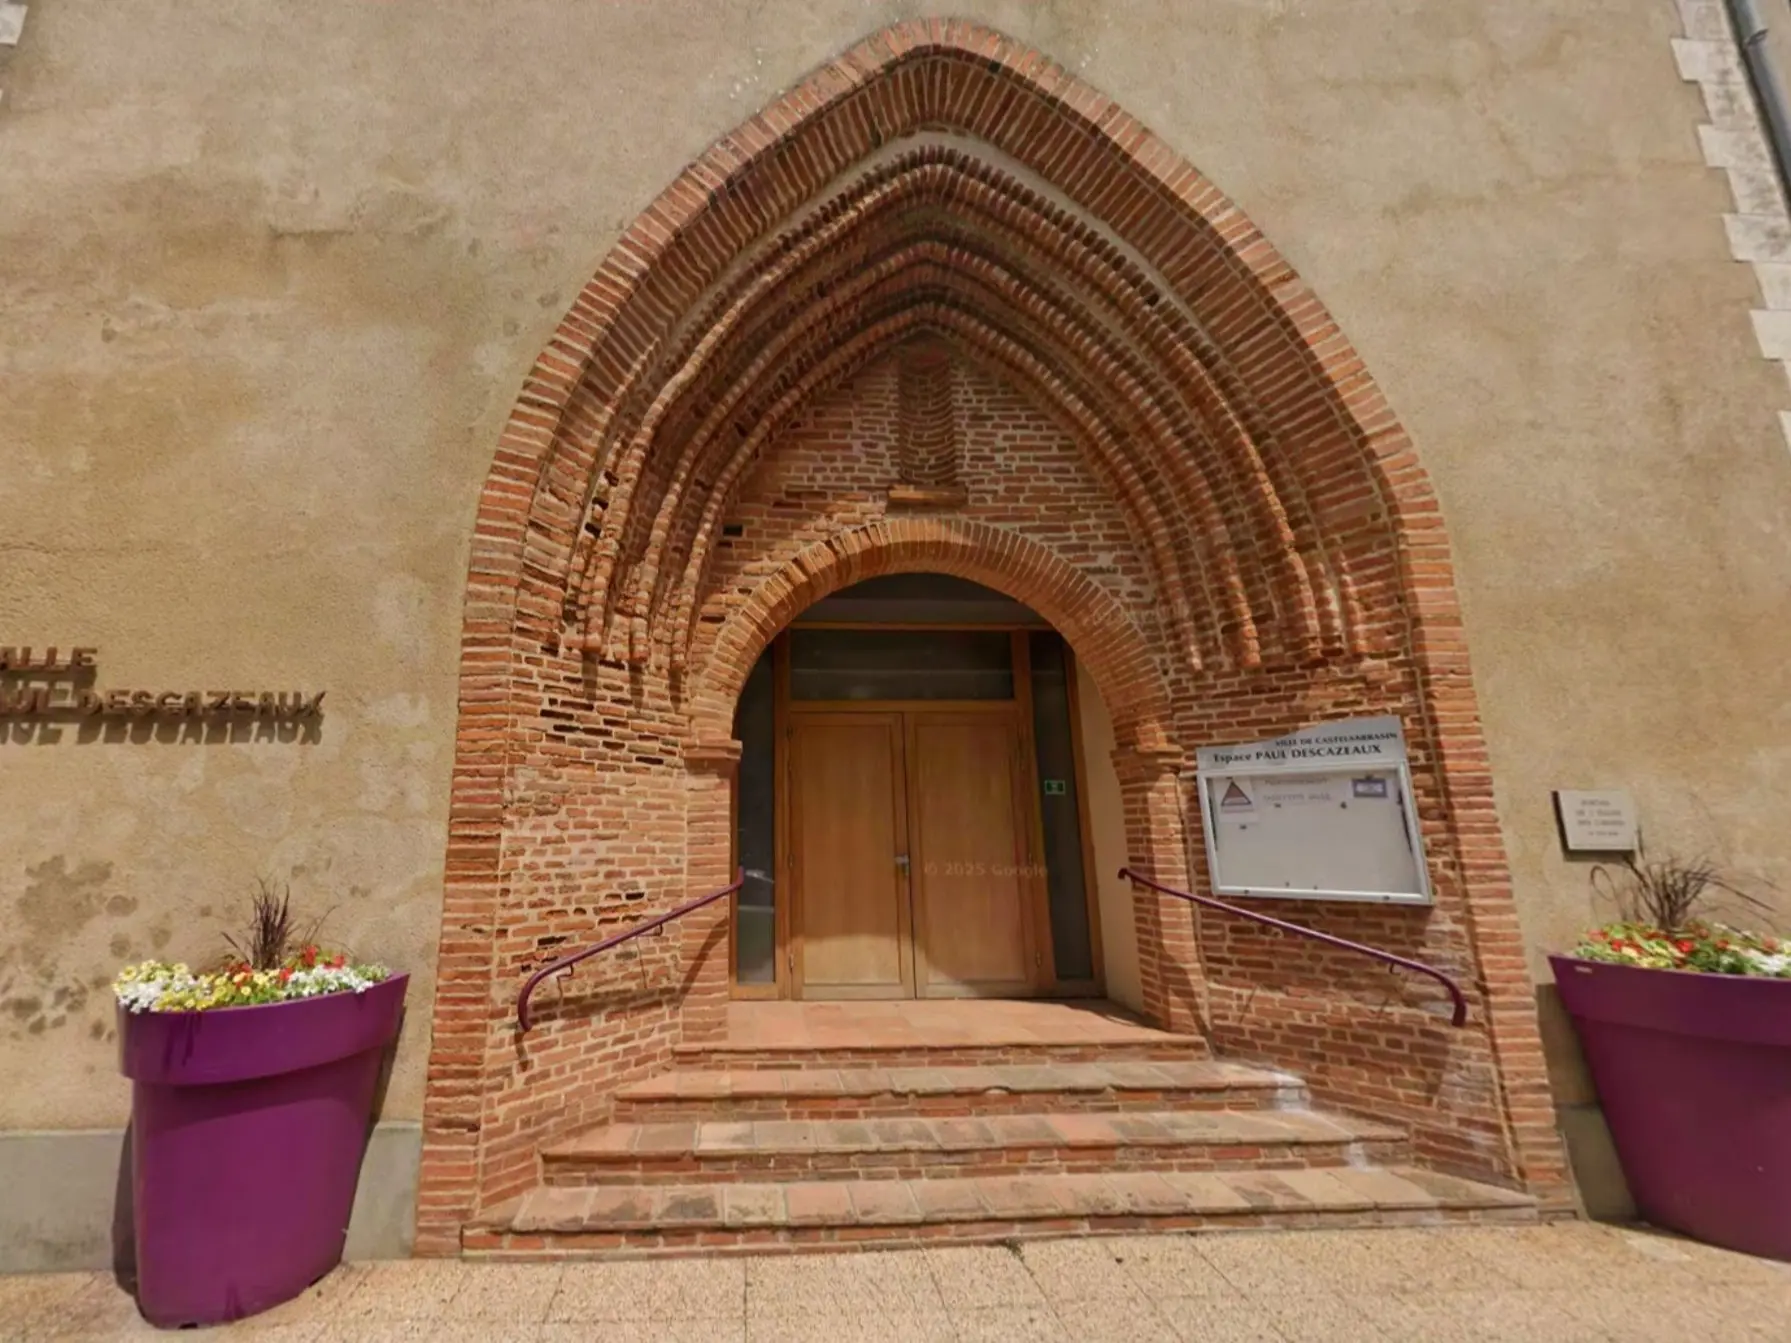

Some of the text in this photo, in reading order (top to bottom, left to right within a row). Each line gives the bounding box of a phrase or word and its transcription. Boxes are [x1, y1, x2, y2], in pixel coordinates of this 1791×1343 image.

[1300, 737, 1314, 746] DE
[1212, 744, 1382, 765] Espace PAUL DESCAZEAUX
